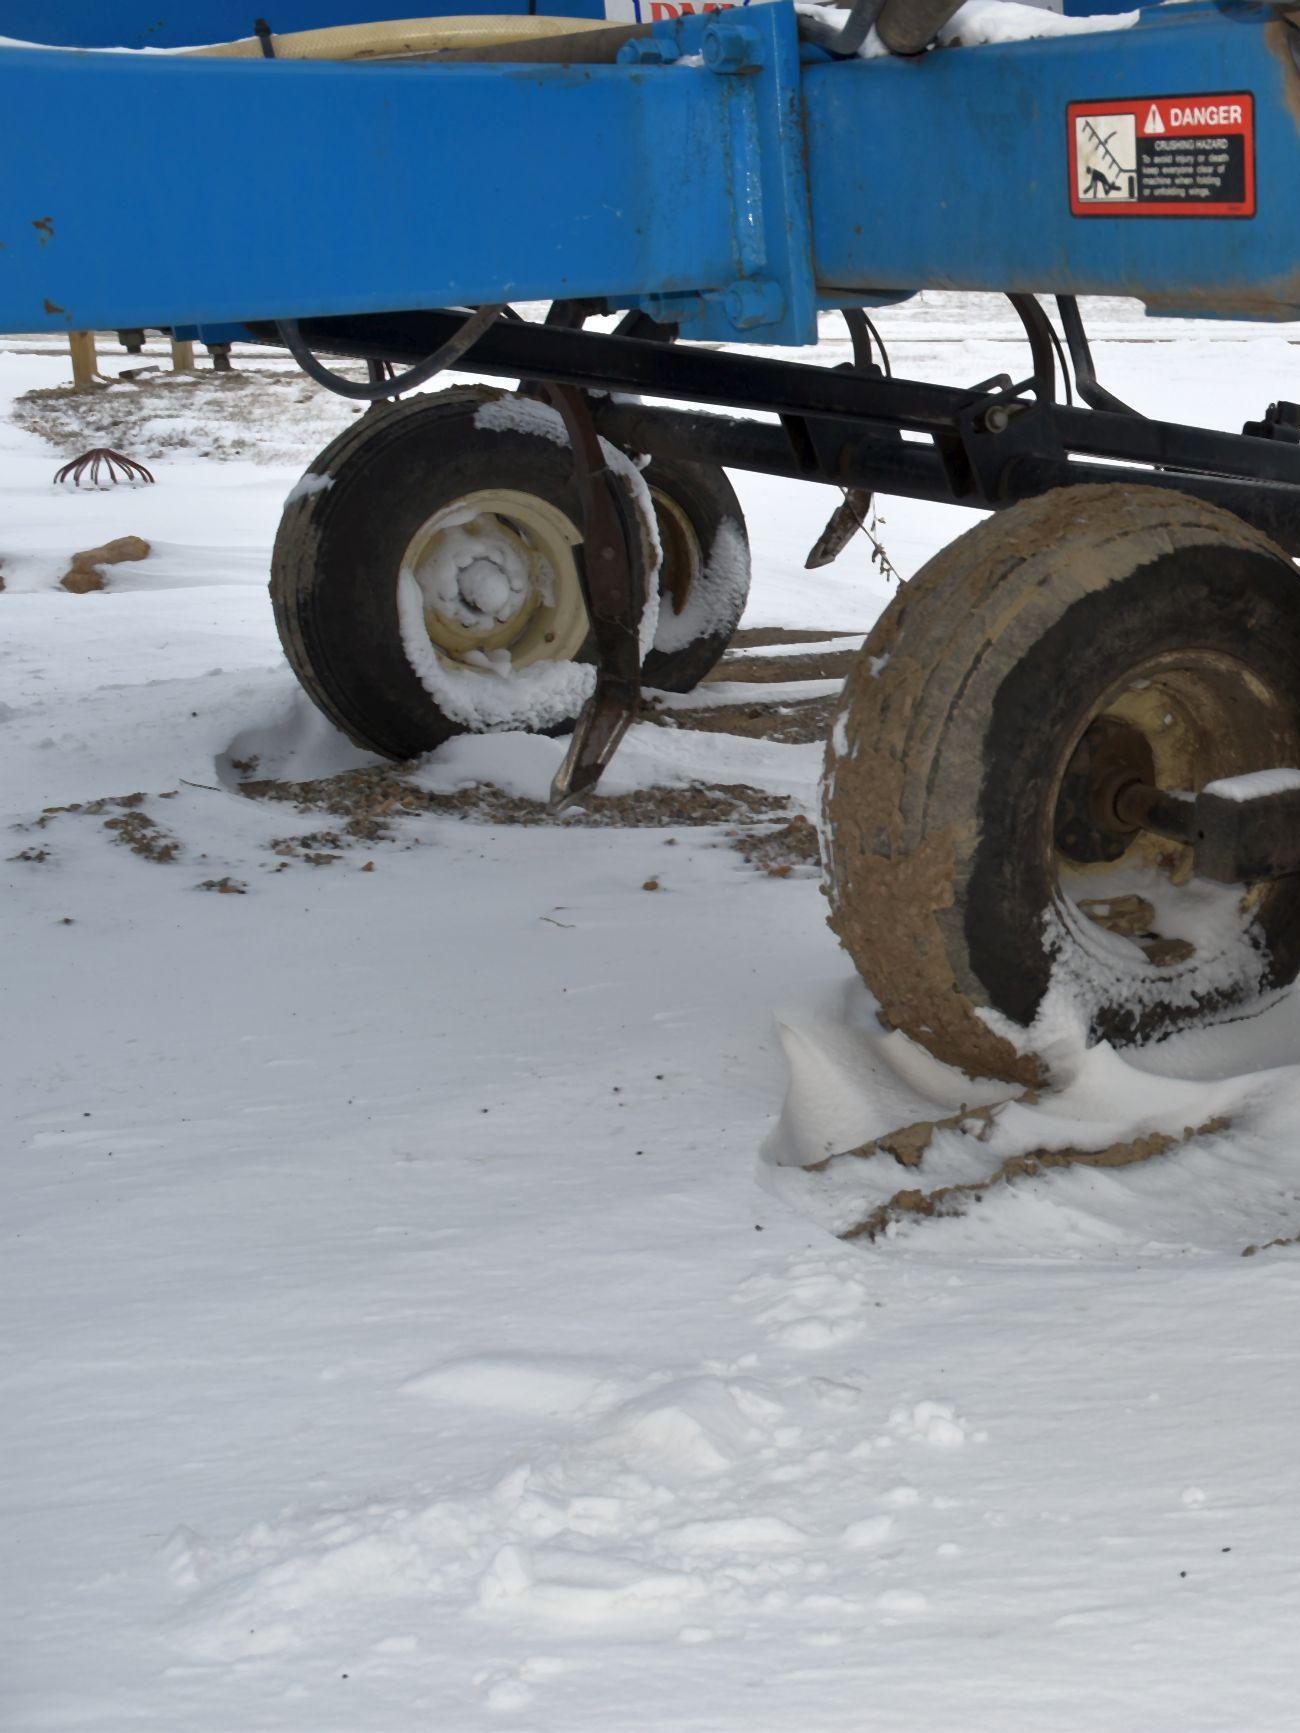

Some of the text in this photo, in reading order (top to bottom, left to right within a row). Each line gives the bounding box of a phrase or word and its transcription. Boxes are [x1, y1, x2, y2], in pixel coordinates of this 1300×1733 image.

[1170, 105, 1242, 126] DANGER
[1154, 138, 1228, 151] CRUSHING HAZARD
